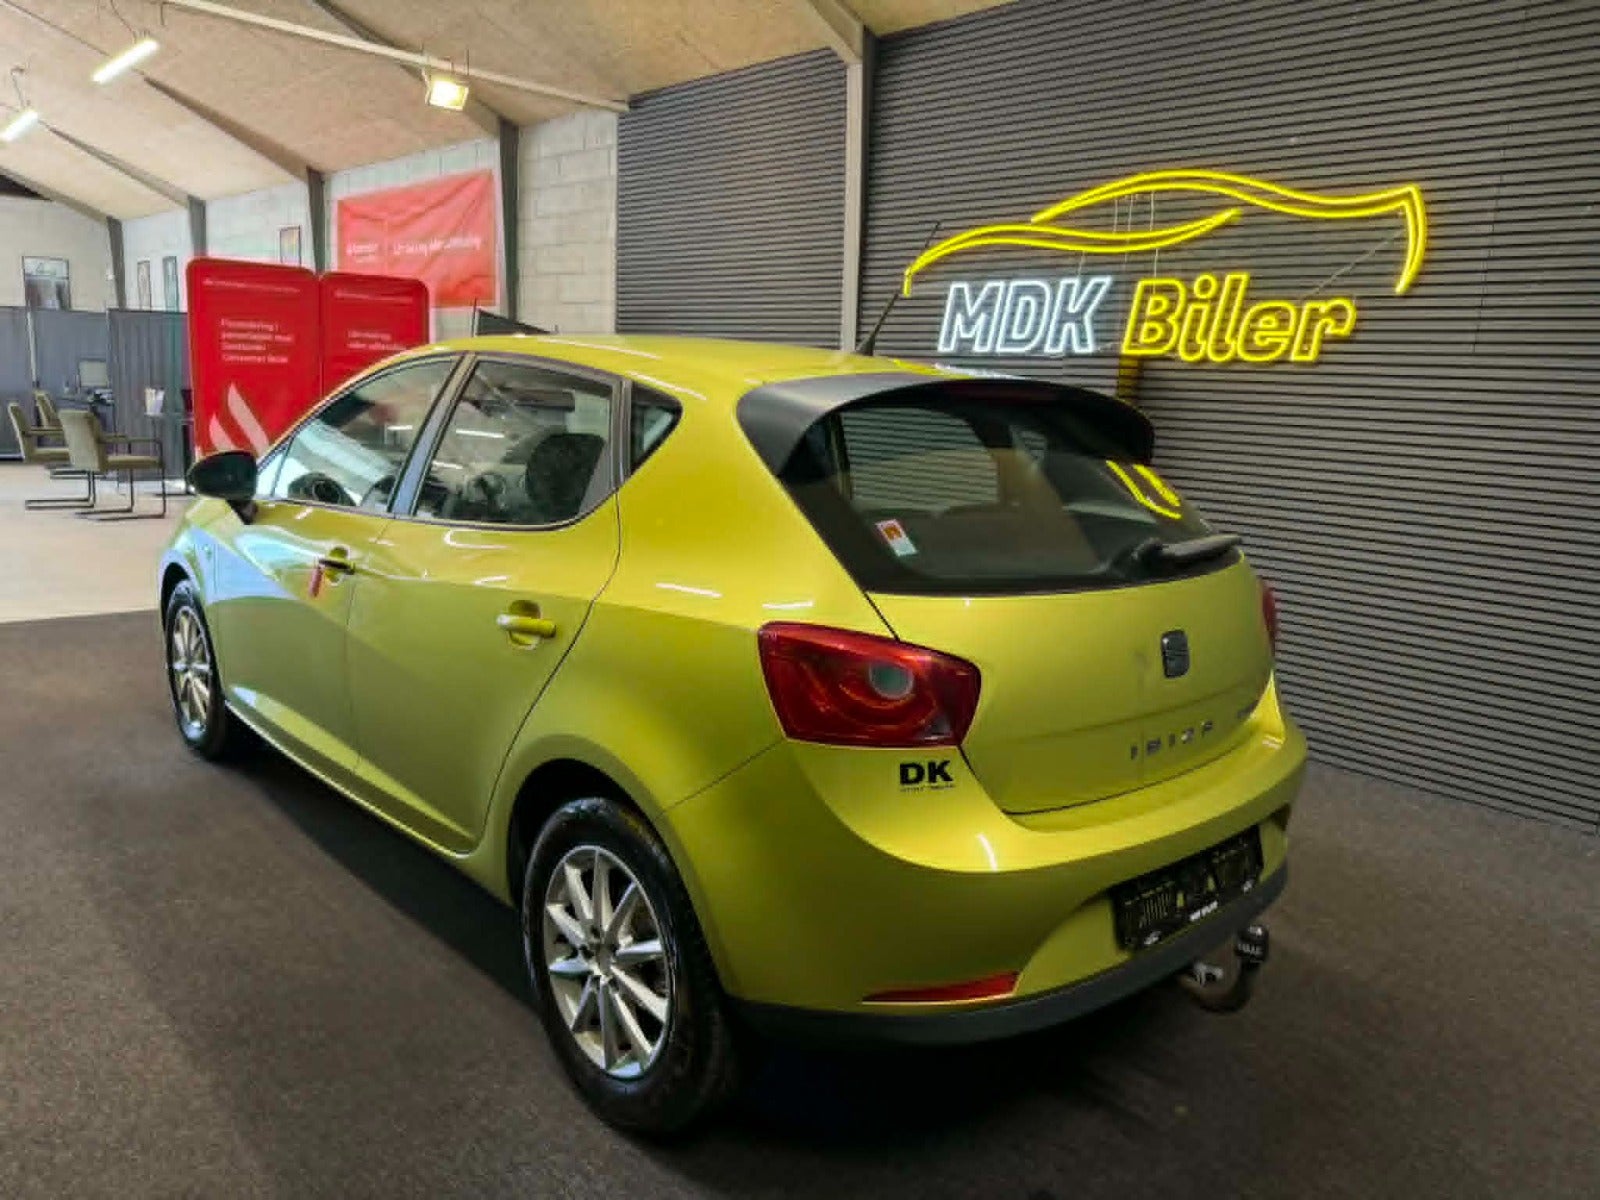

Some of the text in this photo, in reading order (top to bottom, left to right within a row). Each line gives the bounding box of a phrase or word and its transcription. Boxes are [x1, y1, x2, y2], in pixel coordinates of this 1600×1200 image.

[937, 273, 1357, 363] MDK Biler
[899, 760, 954, 785] DK
